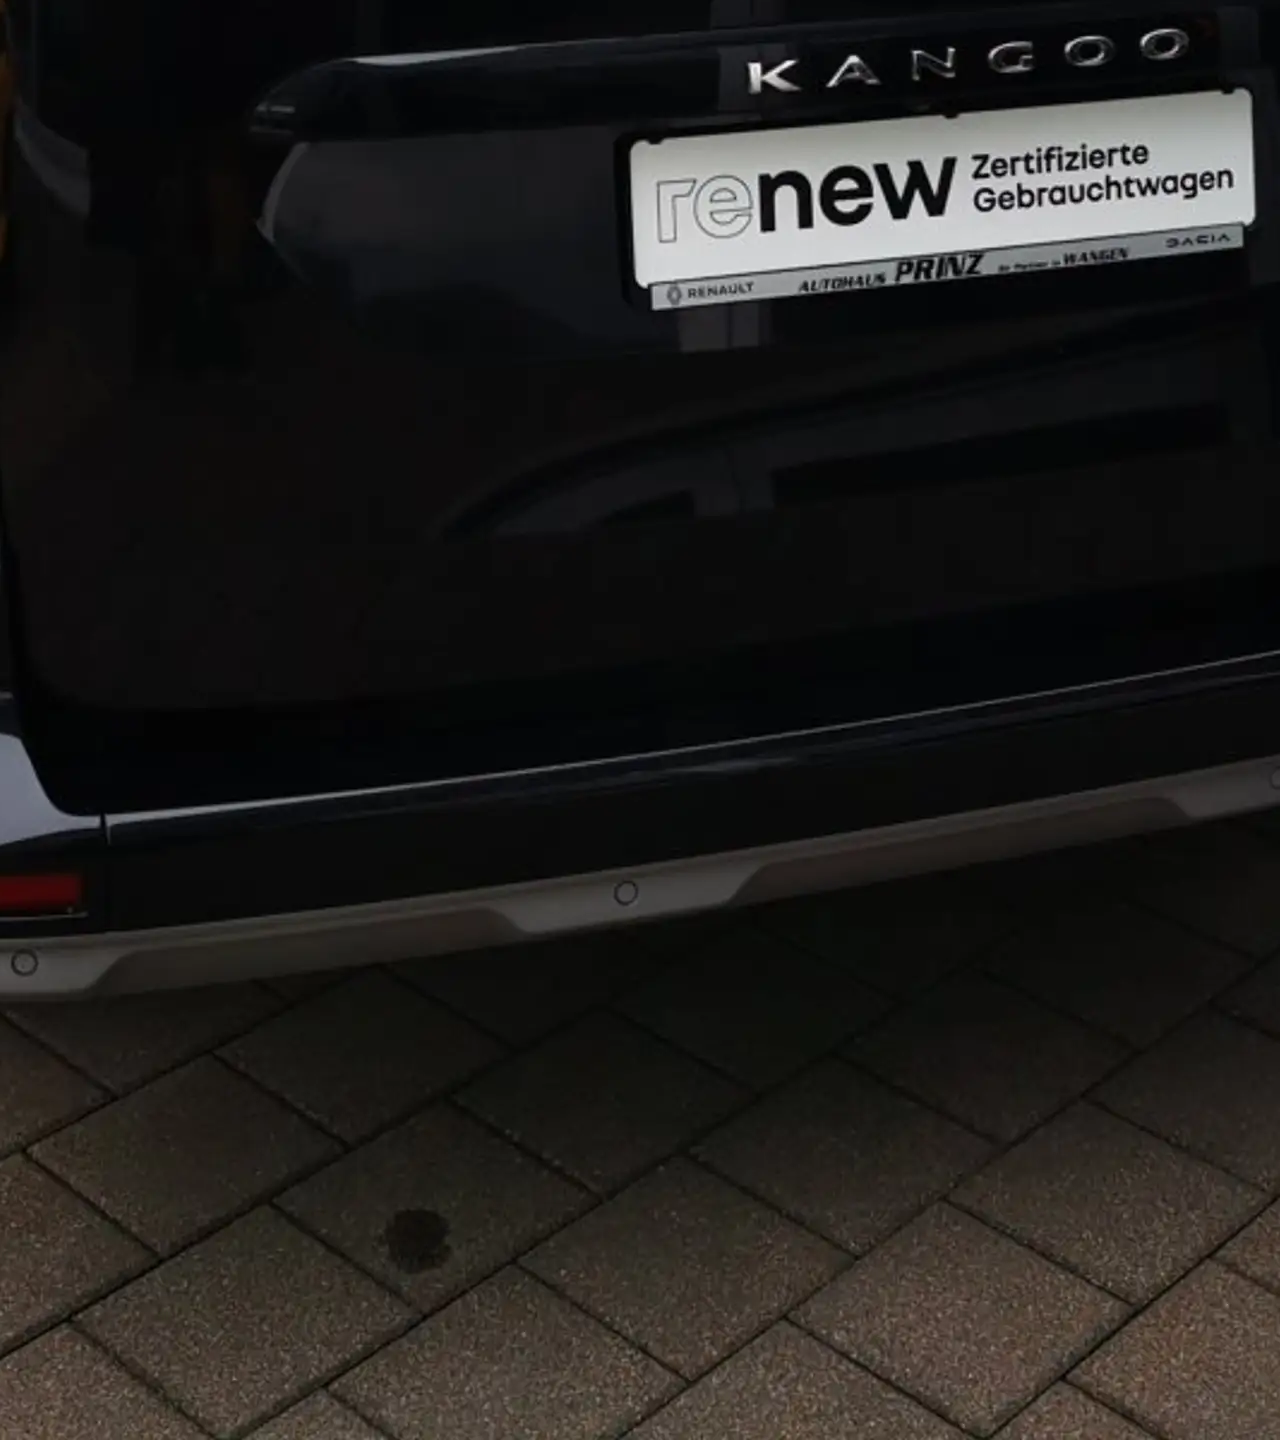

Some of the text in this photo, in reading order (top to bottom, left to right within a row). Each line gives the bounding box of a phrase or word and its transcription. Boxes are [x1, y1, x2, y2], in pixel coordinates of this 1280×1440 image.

[747, 28, 1189, 94] KANGOO
[971, 144, 1150, 179] Zertifizierte
[656, 156, 958, 243] renew
[973, 169, 1235, 212] Gebrauchtwagen
[1166, 234, 1231, 249] DACIA
[687, 281, 755, 299] RENAULT
[799, 272, 887, 293] AUTOHAUS
[895, 253, 985, 282] PRINZ
[1063, 247, 1131, 265] WANGEN
